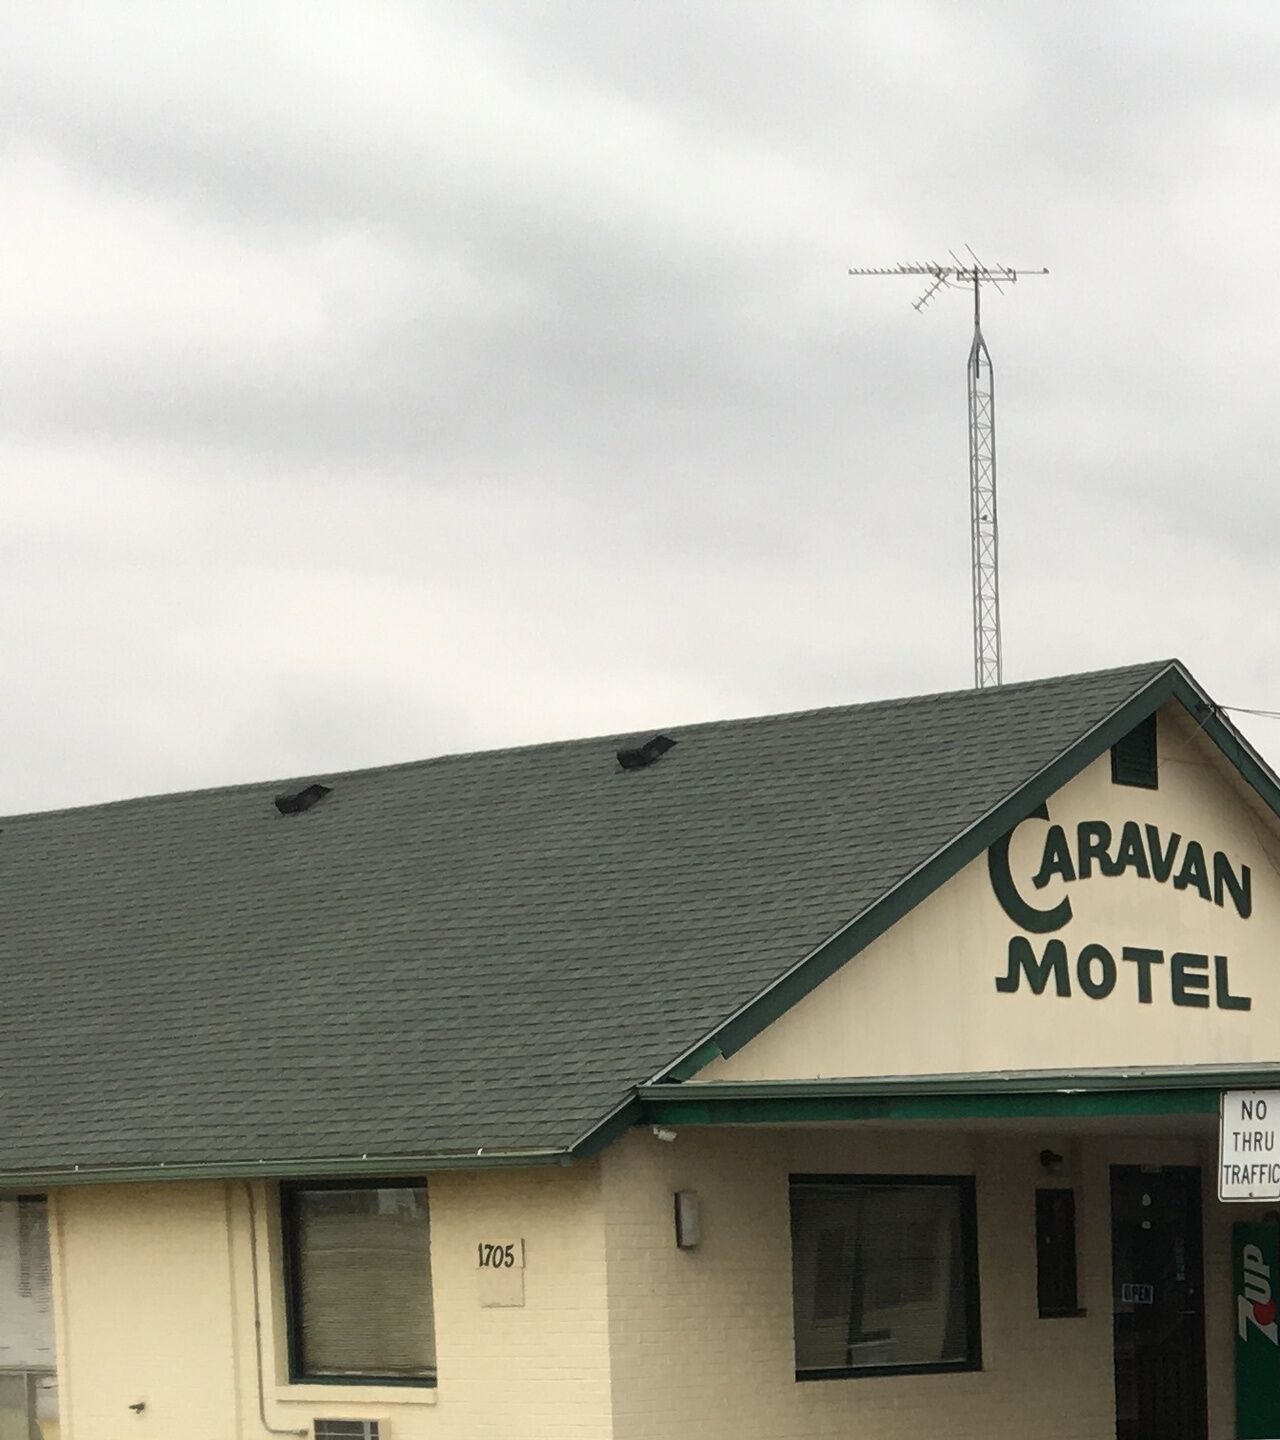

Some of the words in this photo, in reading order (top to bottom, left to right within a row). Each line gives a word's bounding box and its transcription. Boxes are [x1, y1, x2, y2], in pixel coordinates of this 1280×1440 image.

[988, 801, 1252, 934] CARAVAN
[995, 935, 1252, 1011] MOTEL
[1241, 1100, 1267, 1120] NO
[1232, 1131, 1274, 1152] THRU
[1223, 1164, 1280, 1189] TRAFFIC
[478, 1243, 514, 1268] 1705
[1124, 1285, 1151, 1302] OPEN
